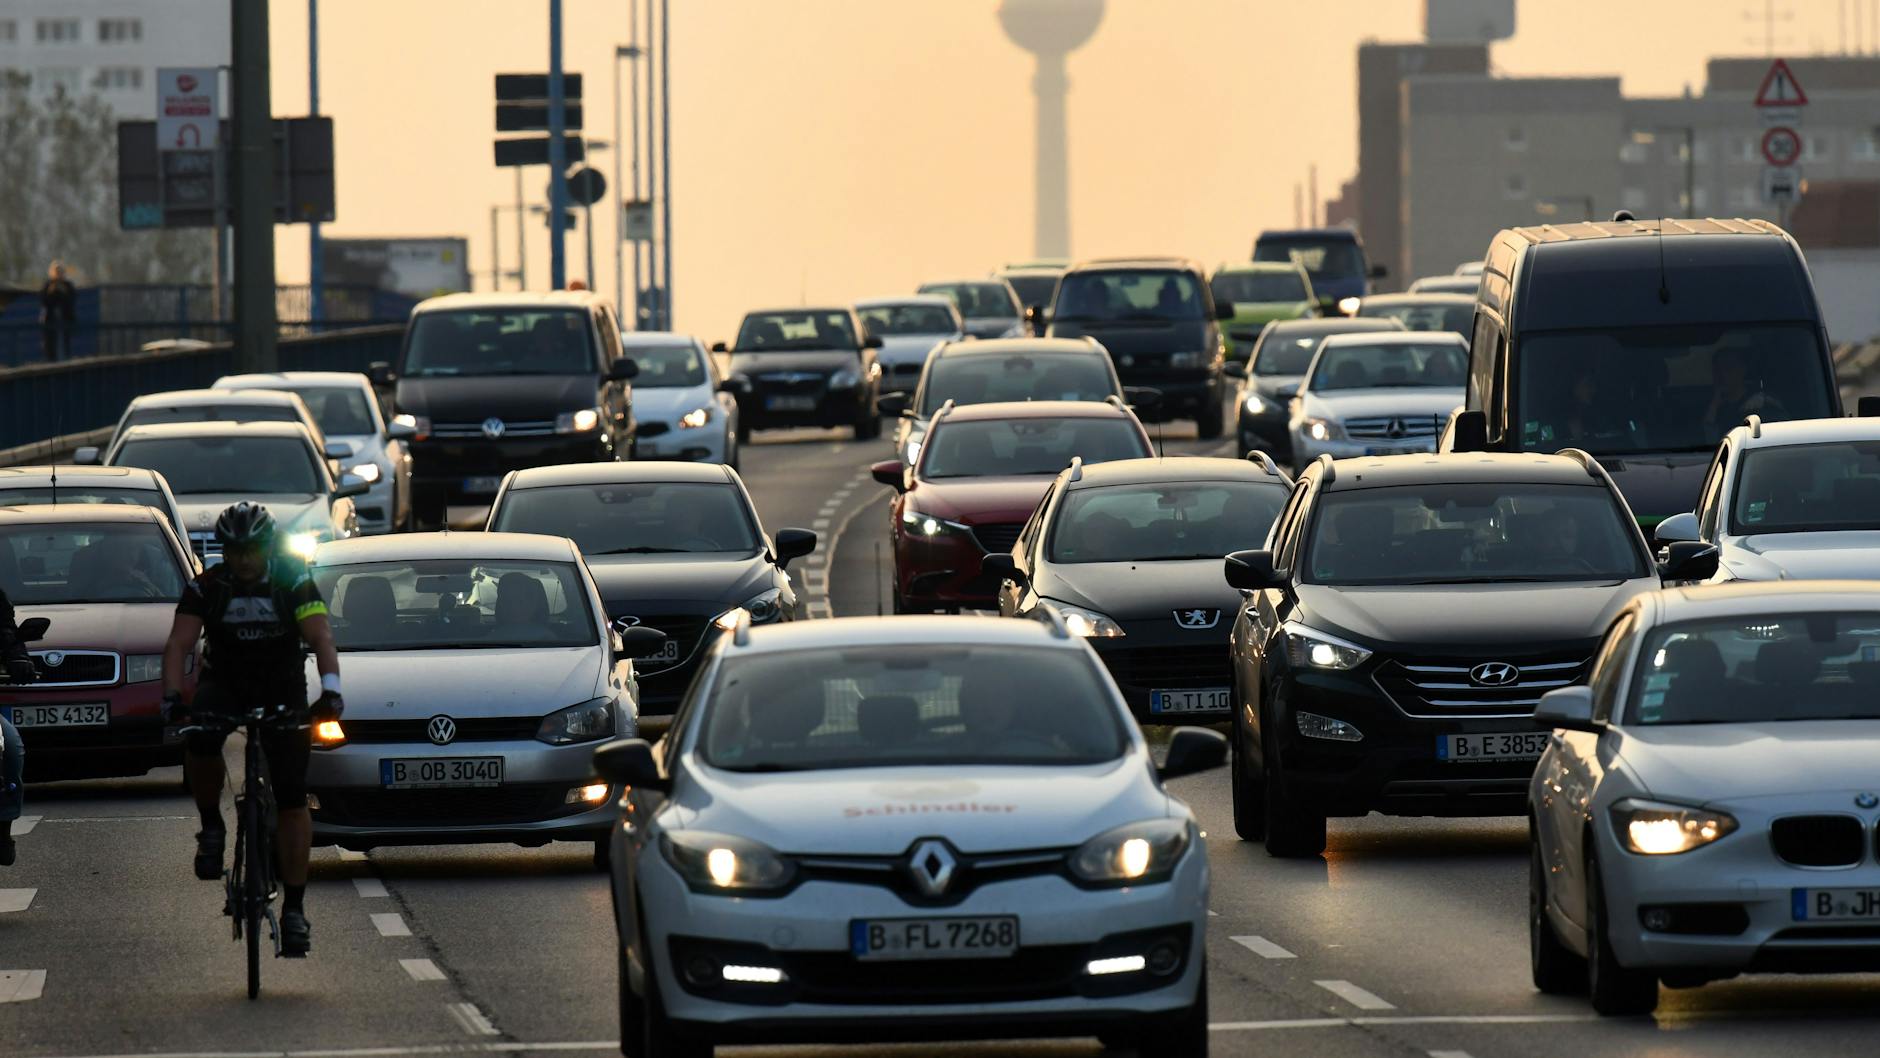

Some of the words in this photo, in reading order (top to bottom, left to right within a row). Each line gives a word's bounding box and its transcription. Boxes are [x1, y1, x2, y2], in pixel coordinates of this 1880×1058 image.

[1162, 694, 1172, 710] B
[1184, 693, 1203, 709] TI
[1208, 692, 1231, 708] 10
[13, 709, 24, 725] B
[36, 707, 58, 725] DS
[63, 706, 105, 723] 4132
[1456, 738, 1469, 756] B
[1483, 737, 1495, 755] E
[1500, 735, 1549, 754] 3853
[394, 763, 407, 781] B
[421, 762, 446, 781] OB
[451, 761, 499, 780] 3040
[843, 802, 1018, 818] Schindler
[1817, 892, 1833, 916] B
[869, 925, 886, 950] B
[906, 923, 941, 949] FL
[945, 921, 1014, 947] 7268
